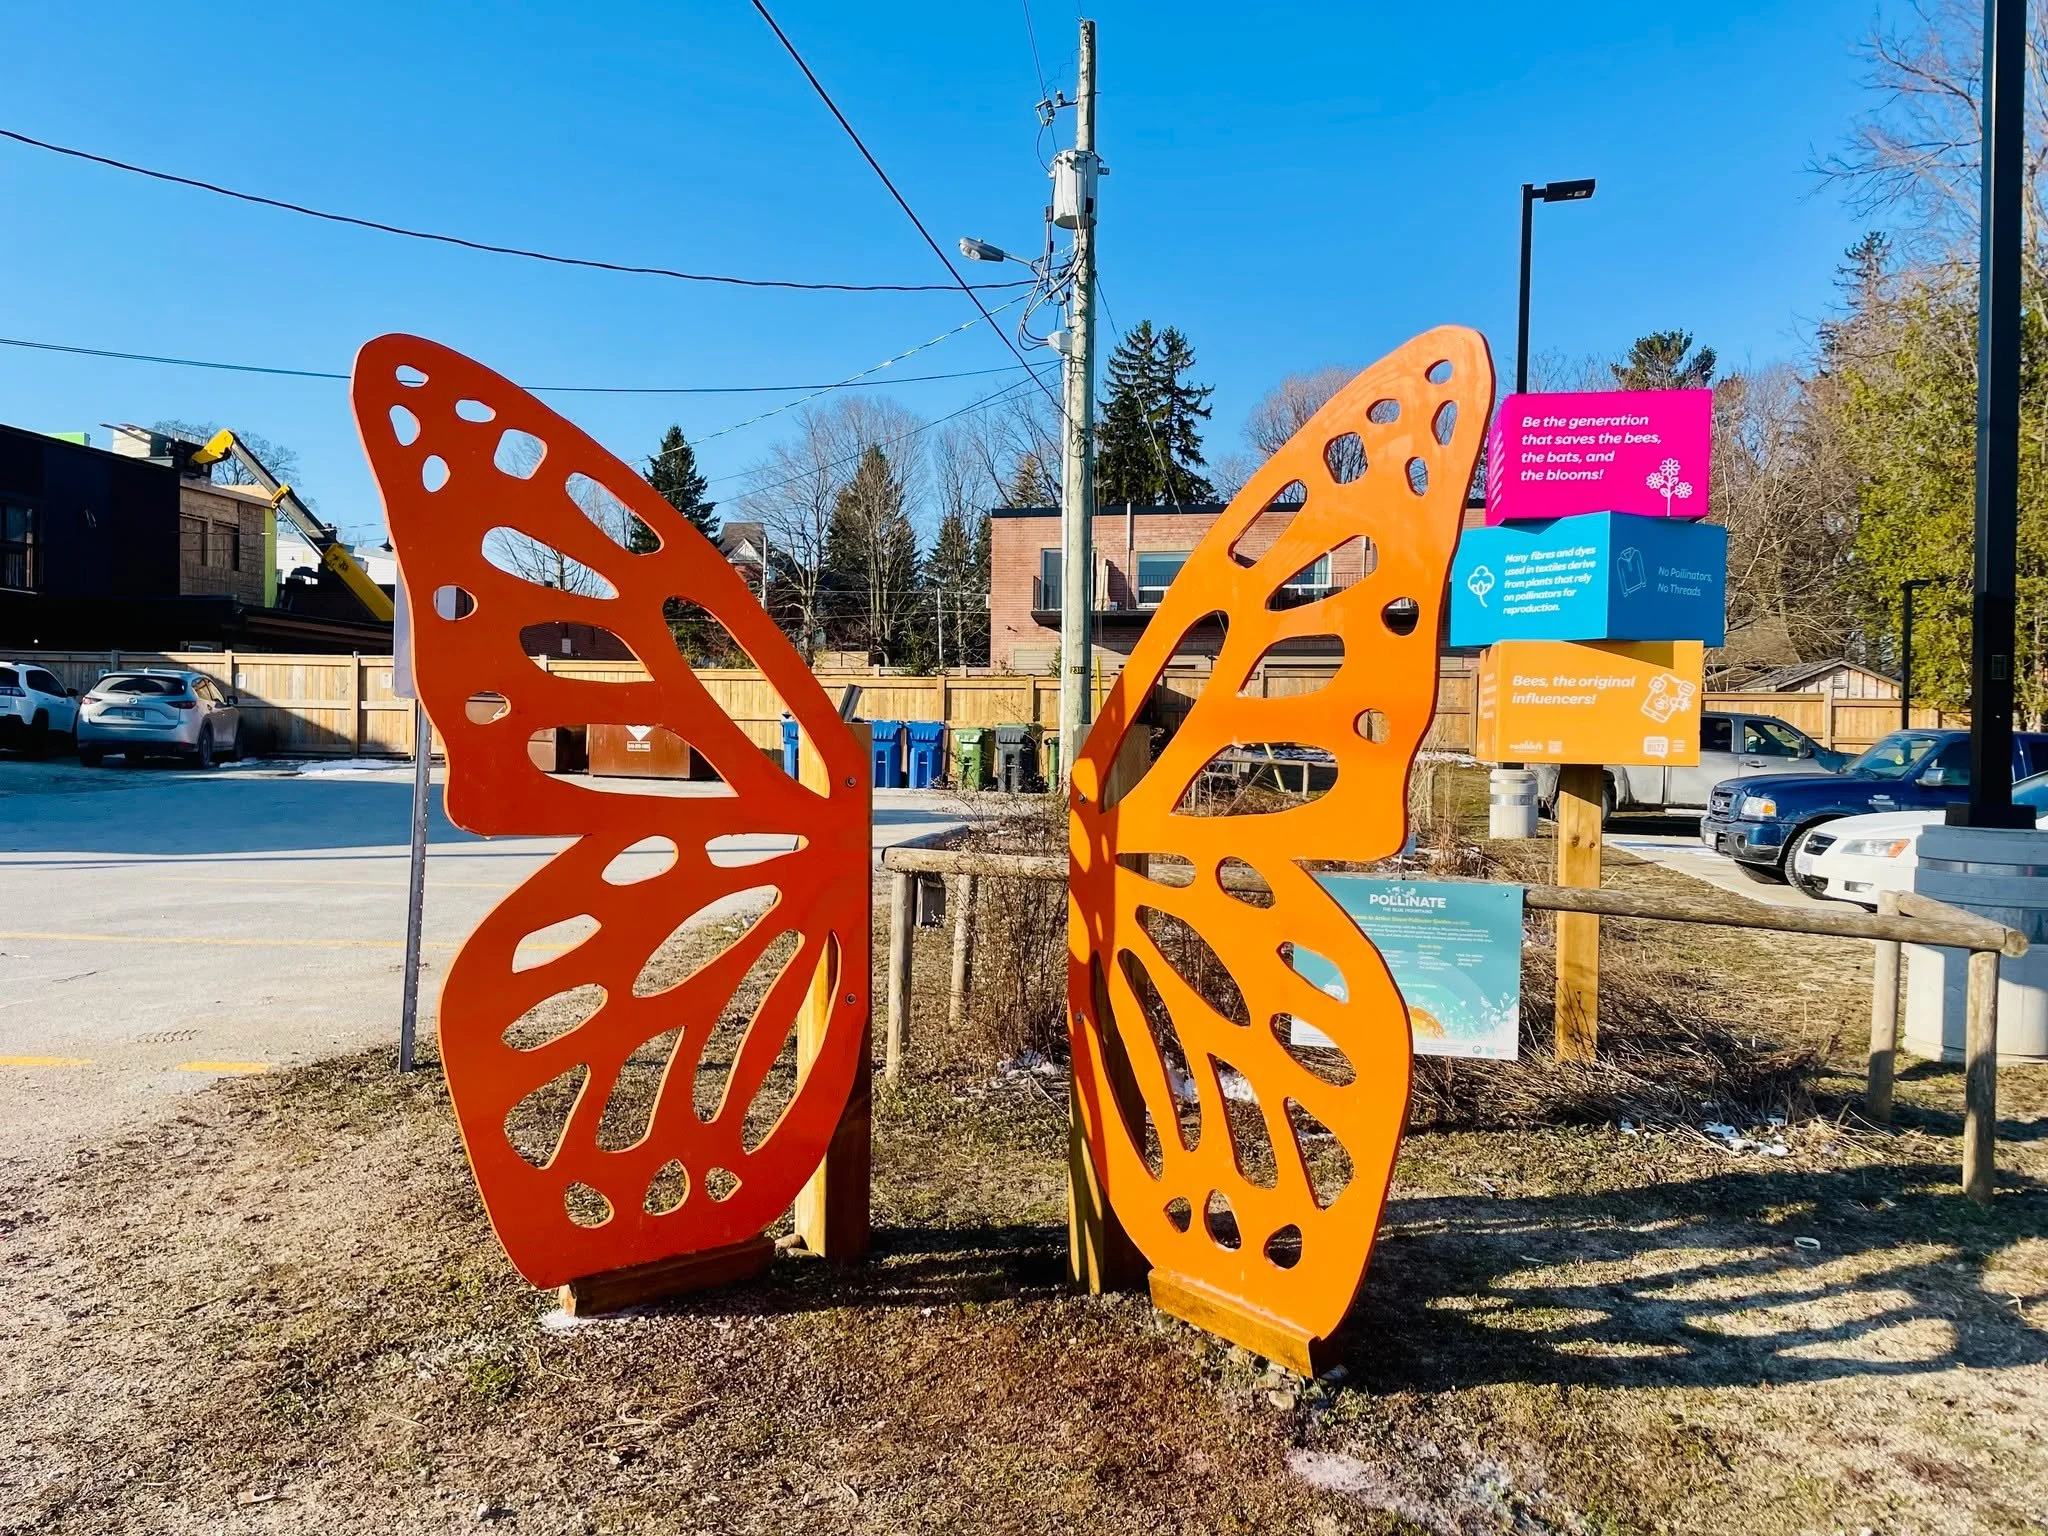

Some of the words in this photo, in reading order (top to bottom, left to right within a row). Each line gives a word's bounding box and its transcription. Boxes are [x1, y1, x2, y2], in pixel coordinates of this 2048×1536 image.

[1522, 416, 1541, 428] Be
[1543, 416, 1567, 428] the
[1568, 414, 1649, 430] generation
[1521, 434, 1553, 446] that
[1554, 434, 1596, 446] saves
[1598, 432, 1622, 445] the
[1624, 432, 1662, 445] bees,
[1521, 452, 1545, 464] the
[1546, 451, 1583, 465] bats,
[1585, 450, 1616, 463] and
[1520, 469, 1544, 482] the
[1546, 468, 1605, 481] blooms!
[1505, 554, 1529, 564] Many
[1530, 550, 1556, 561] fibres
[1556, 547, 1575, 558] and
[1574, 546, 1597, 558] dyes
[1504, 565, 1526, 577] used
[1525, 565, 1535, 575] in
[1535, 562, 1567, 574] textiles
[1567, 559, 1597, 570] derive
[1658, 566, 1670, 577] No
[1670, 567, 1713, 584] Pollinators,
[1504, 579, 1525, 589] from
[1525, 577, 1553, 589] plants
[1554, 575, 1574, 586] that
[1574, 572, 1593, 585] rely
[1503, 594, 1515, 602] on
[1514, 590, 1563, 603] pollinators
[1563, 587, 1577, 597] for
[1657, 582, 1669, 593] No
[1670, 583, 1701, 597] Threads
[1503, 603, 1561, 617] reproduction.
[1512, 674, 1549, 688] Bees,
[1552, 674, 1576, 688] the
[1578, 675, 1636, 690] original
[1511, 691, 1598, 706] influencers!
